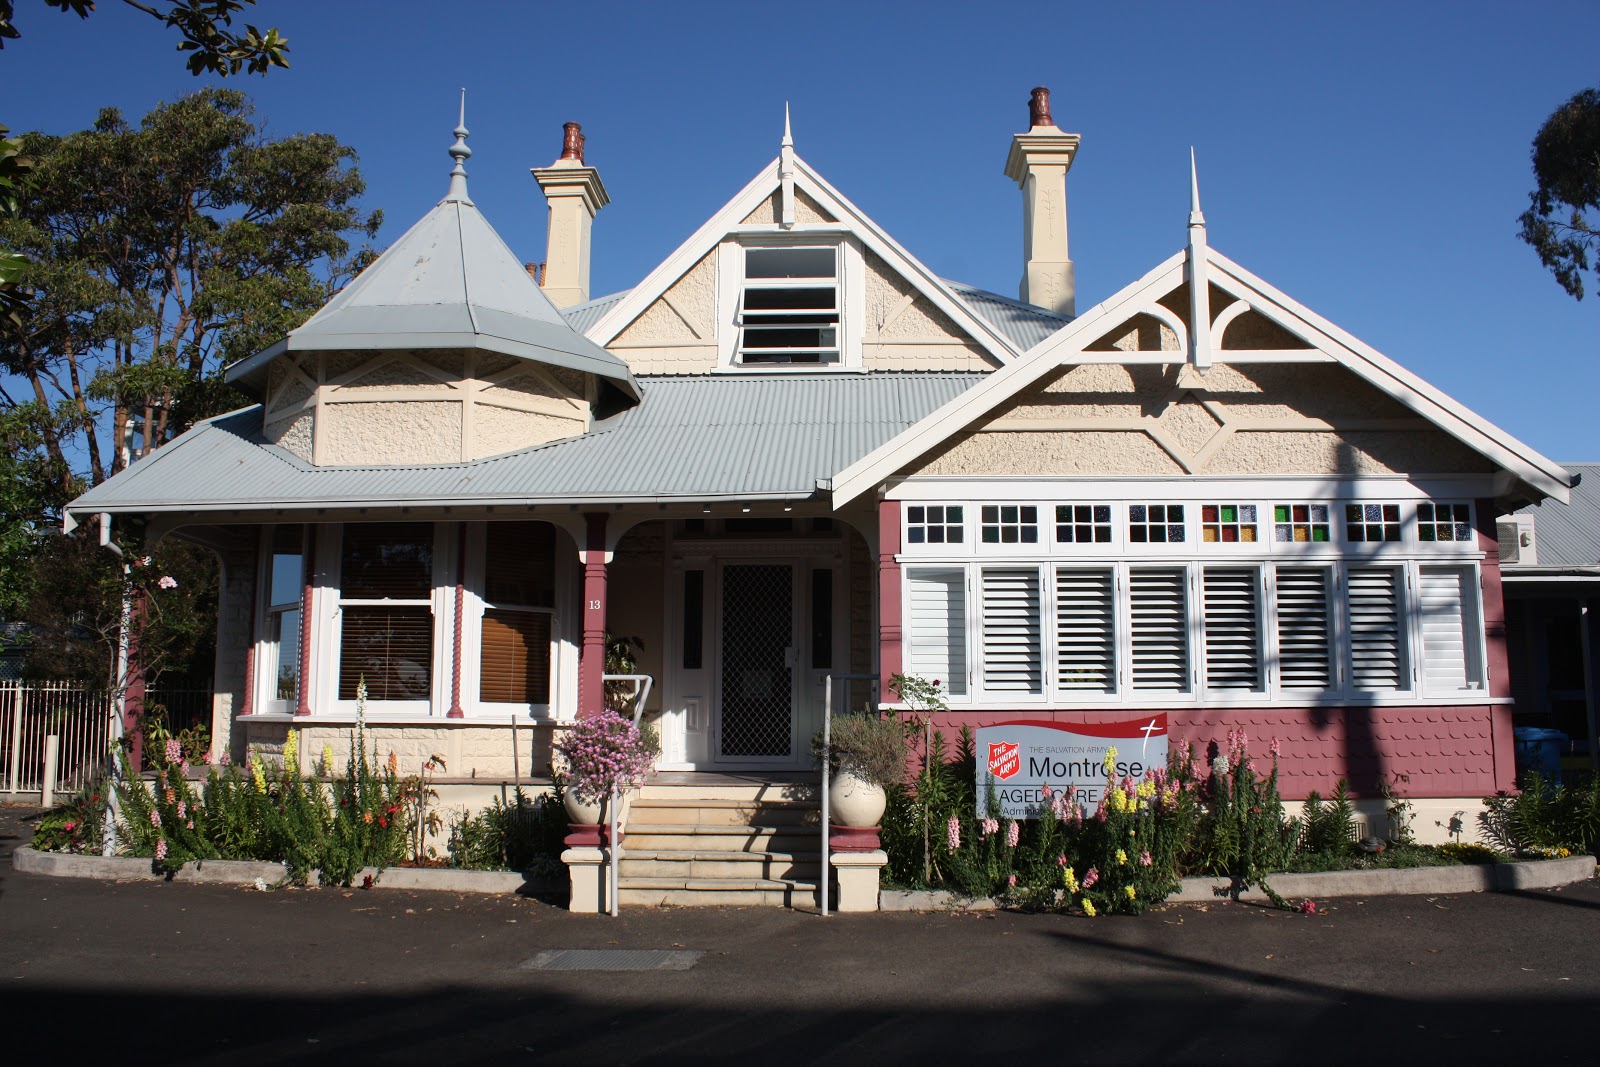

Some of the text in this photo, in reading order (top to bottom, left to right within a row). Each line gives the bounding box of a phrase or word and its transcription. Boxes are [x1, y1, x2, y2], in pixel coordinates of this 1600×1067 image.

[589, 600, 601, 610] 13
[993, 743, 1007, 757] THE
[1029, 746, 1108, 754] THE SALVATION ARMY
[989, 745, 1019, 770] SALVATION
[999, 757, 1017, 776] ARMY
[999, 789, 1047, 803] AGED
